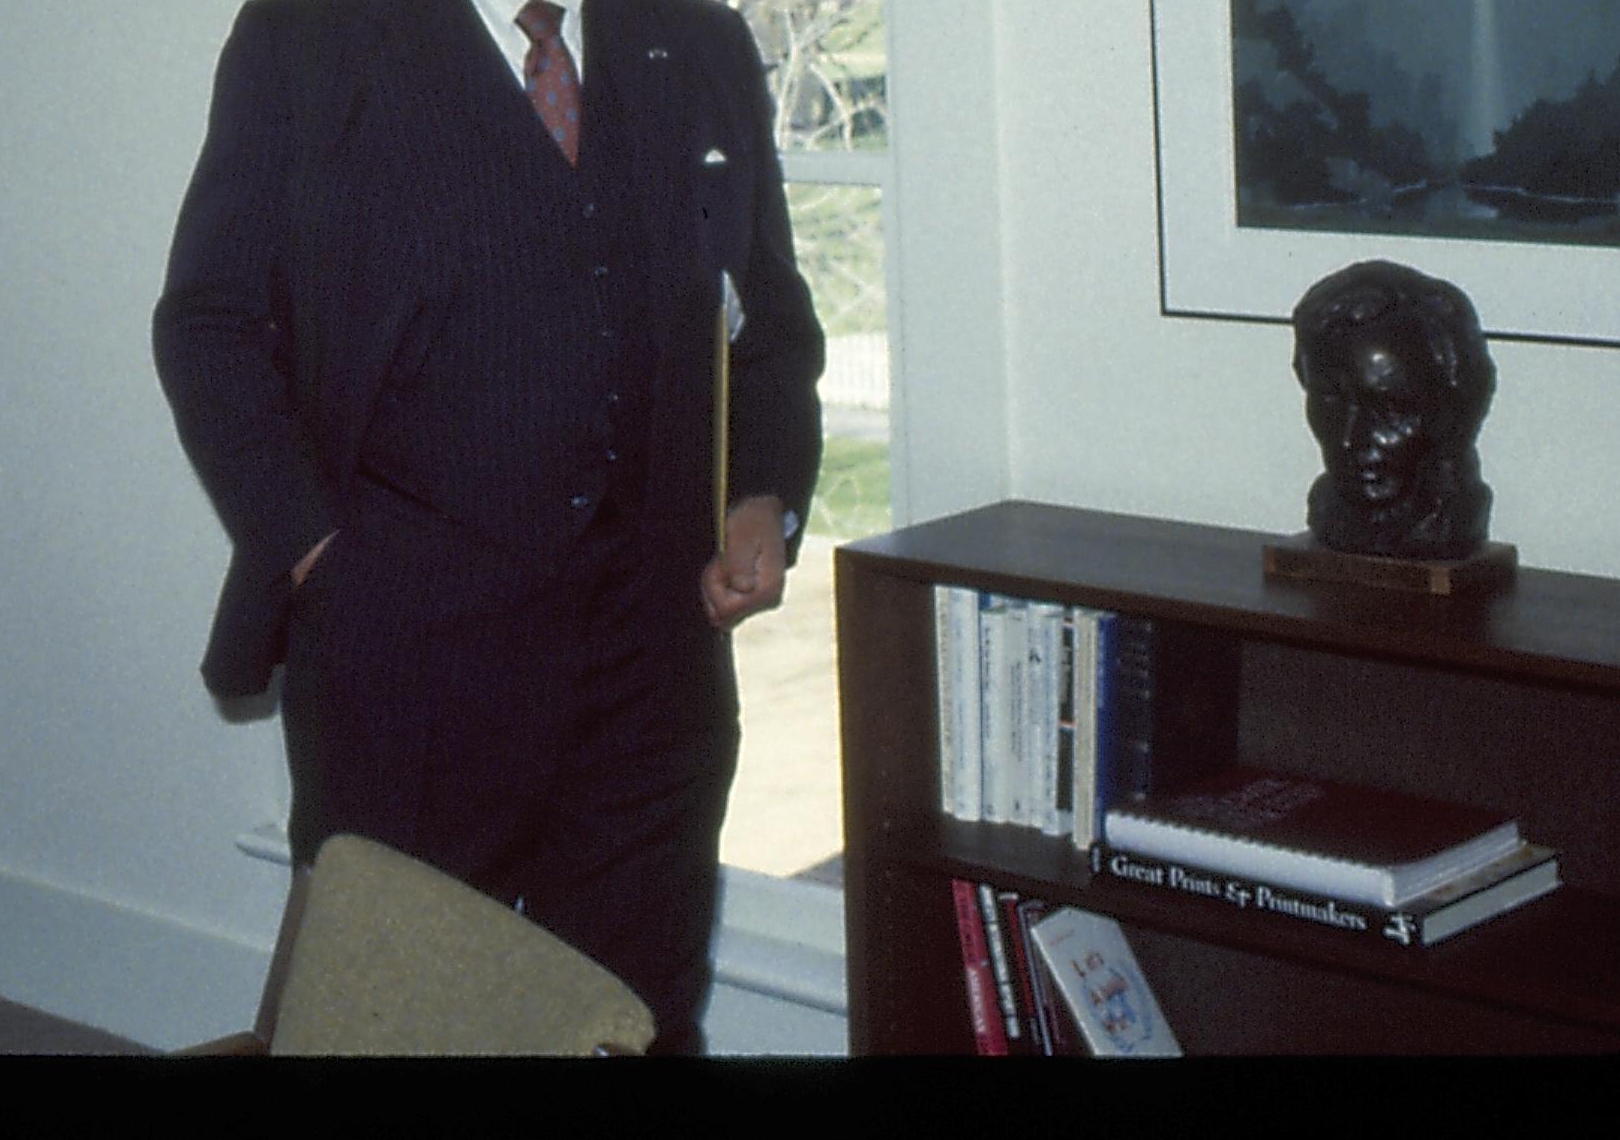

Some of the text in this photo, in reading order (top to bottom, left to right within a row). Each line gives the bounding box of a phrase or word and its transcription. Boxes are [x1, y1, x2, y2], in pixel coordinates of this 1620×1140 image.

[1112, 854, 1368, 932] Great Prints & Printmakers
